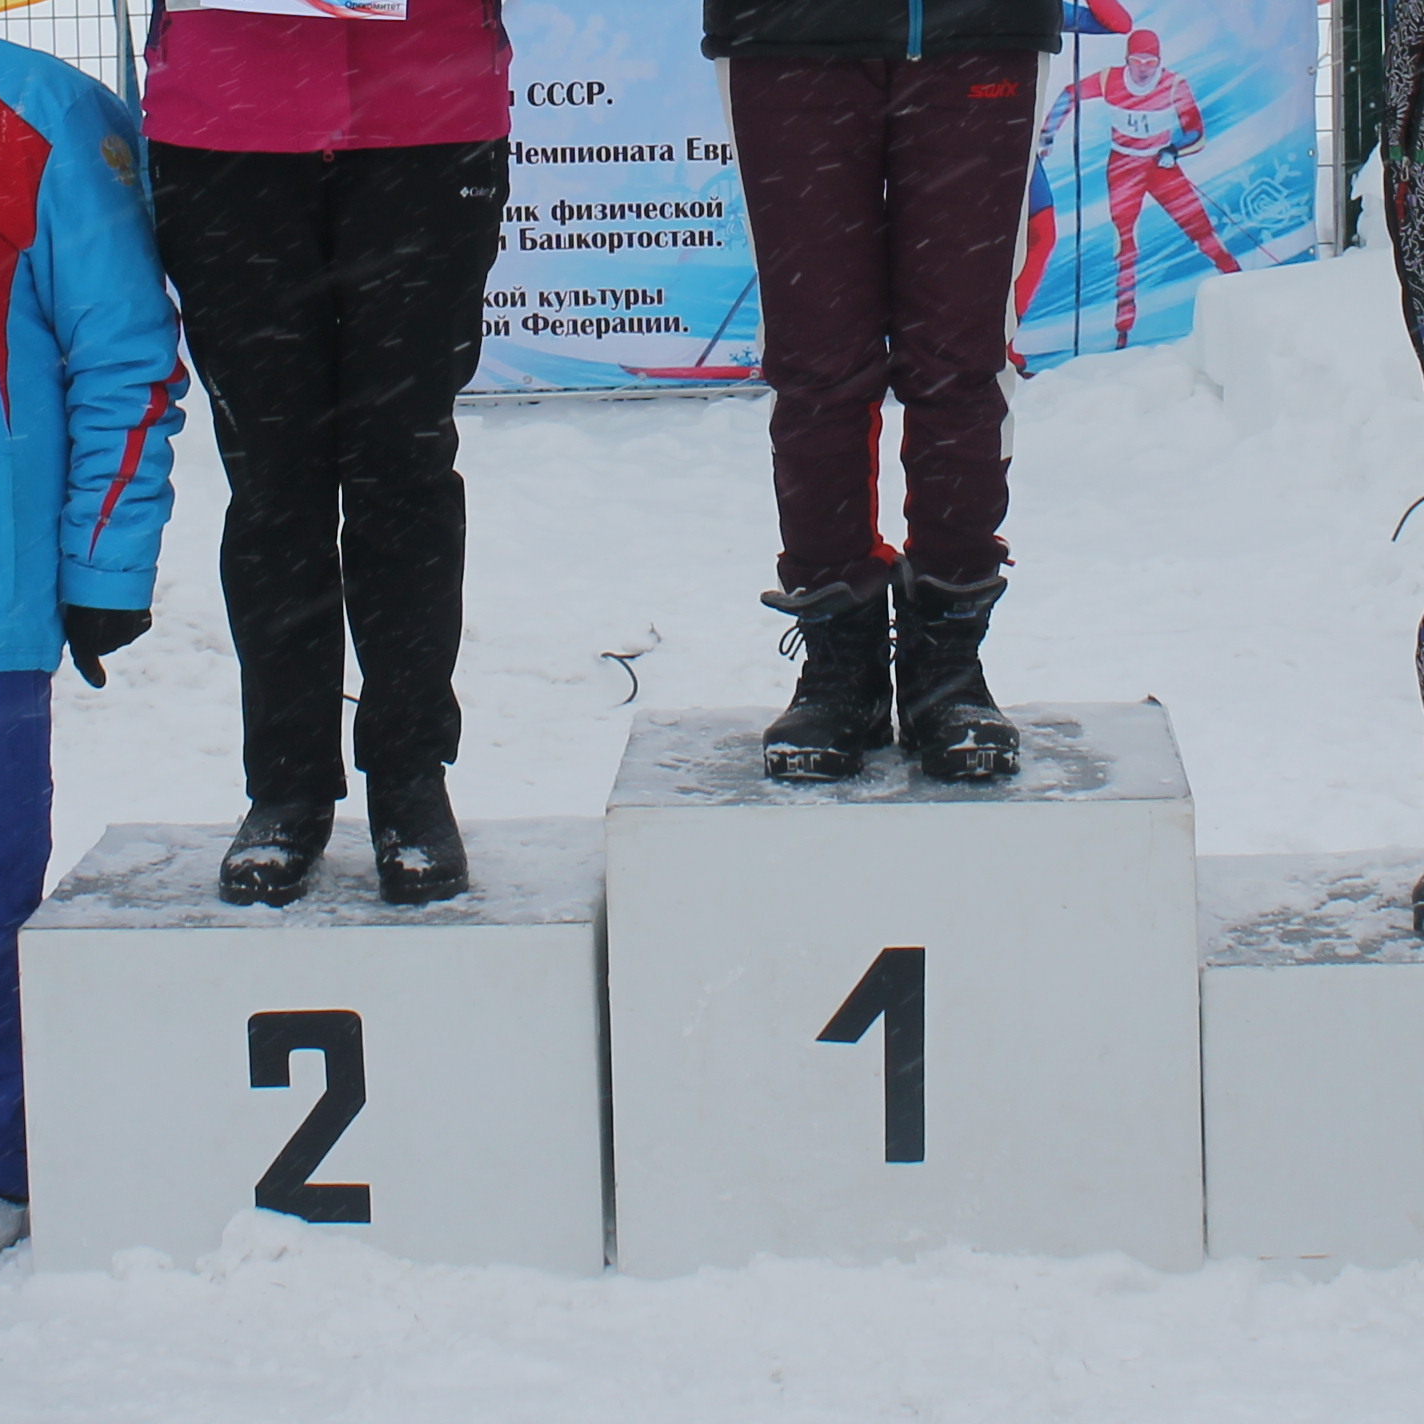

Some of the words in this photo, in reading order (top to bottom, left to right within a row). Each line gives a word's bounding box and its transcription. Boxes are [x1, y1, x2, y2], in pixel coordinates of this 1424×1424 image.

[527, 81, 613, 106] СССР.
[508, 141, 674, 164] Чемпионата
[551, 196, 723, 225] физической
[519, 227, 722, 254] Башкортостан.
[538, 288, 663, 312] культуры
[521, 312, 689, 339] Федерации.
[816, 948, 925, 1164] 1
[247, 1009, 371, 1224] 2
